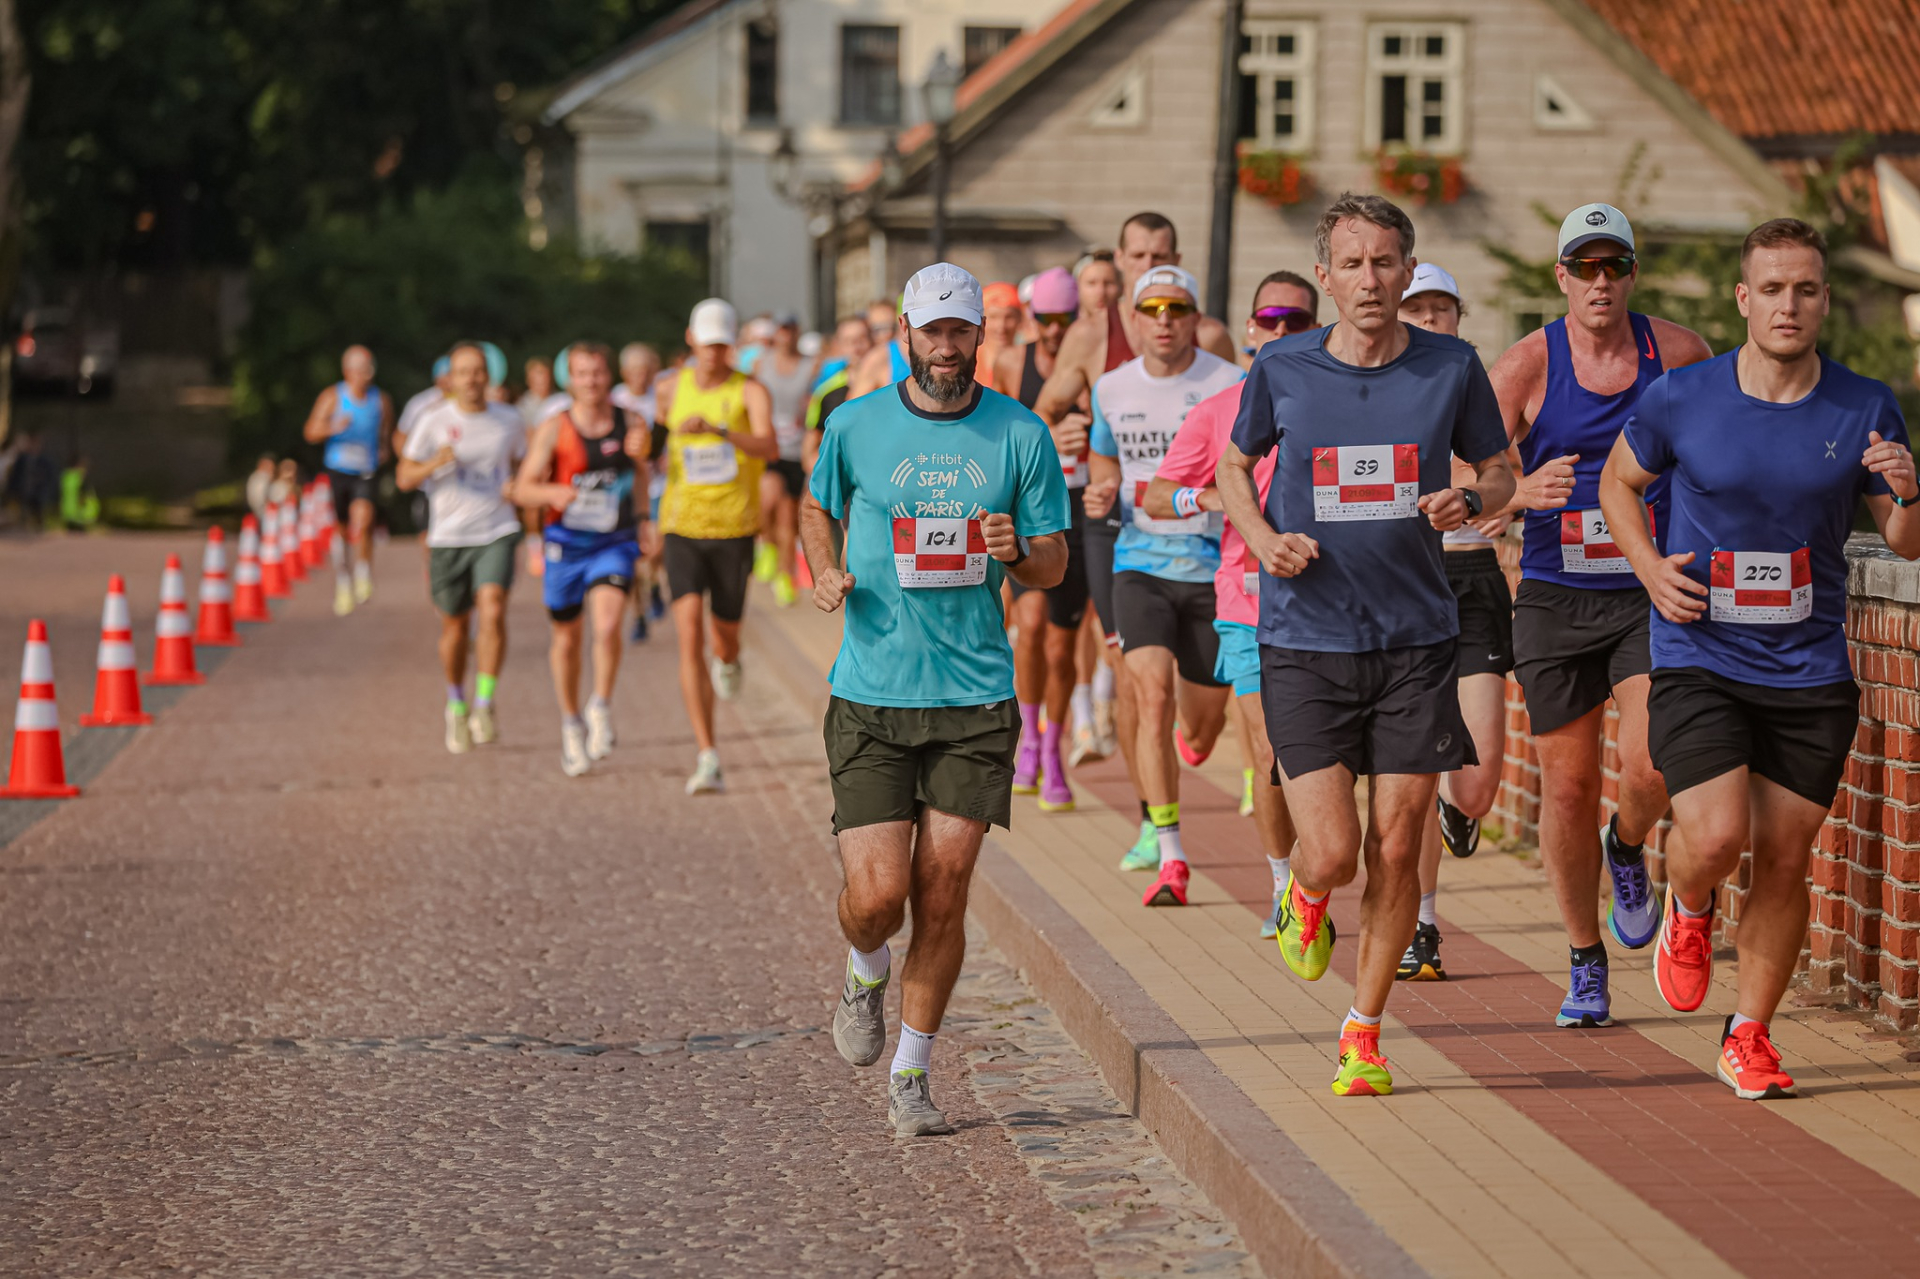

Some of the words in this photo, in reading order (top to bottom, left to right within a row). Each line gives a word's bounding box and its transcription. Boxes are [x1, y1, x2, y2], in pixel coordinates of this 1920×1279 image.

[931, 453, 963, 465] fitbit
[1353, 459, 1379, 476] 89
[931, 489, 947, 499] DE
[925, 531, 957, 546] 104
[1743, 565, 1782, 581] 270
